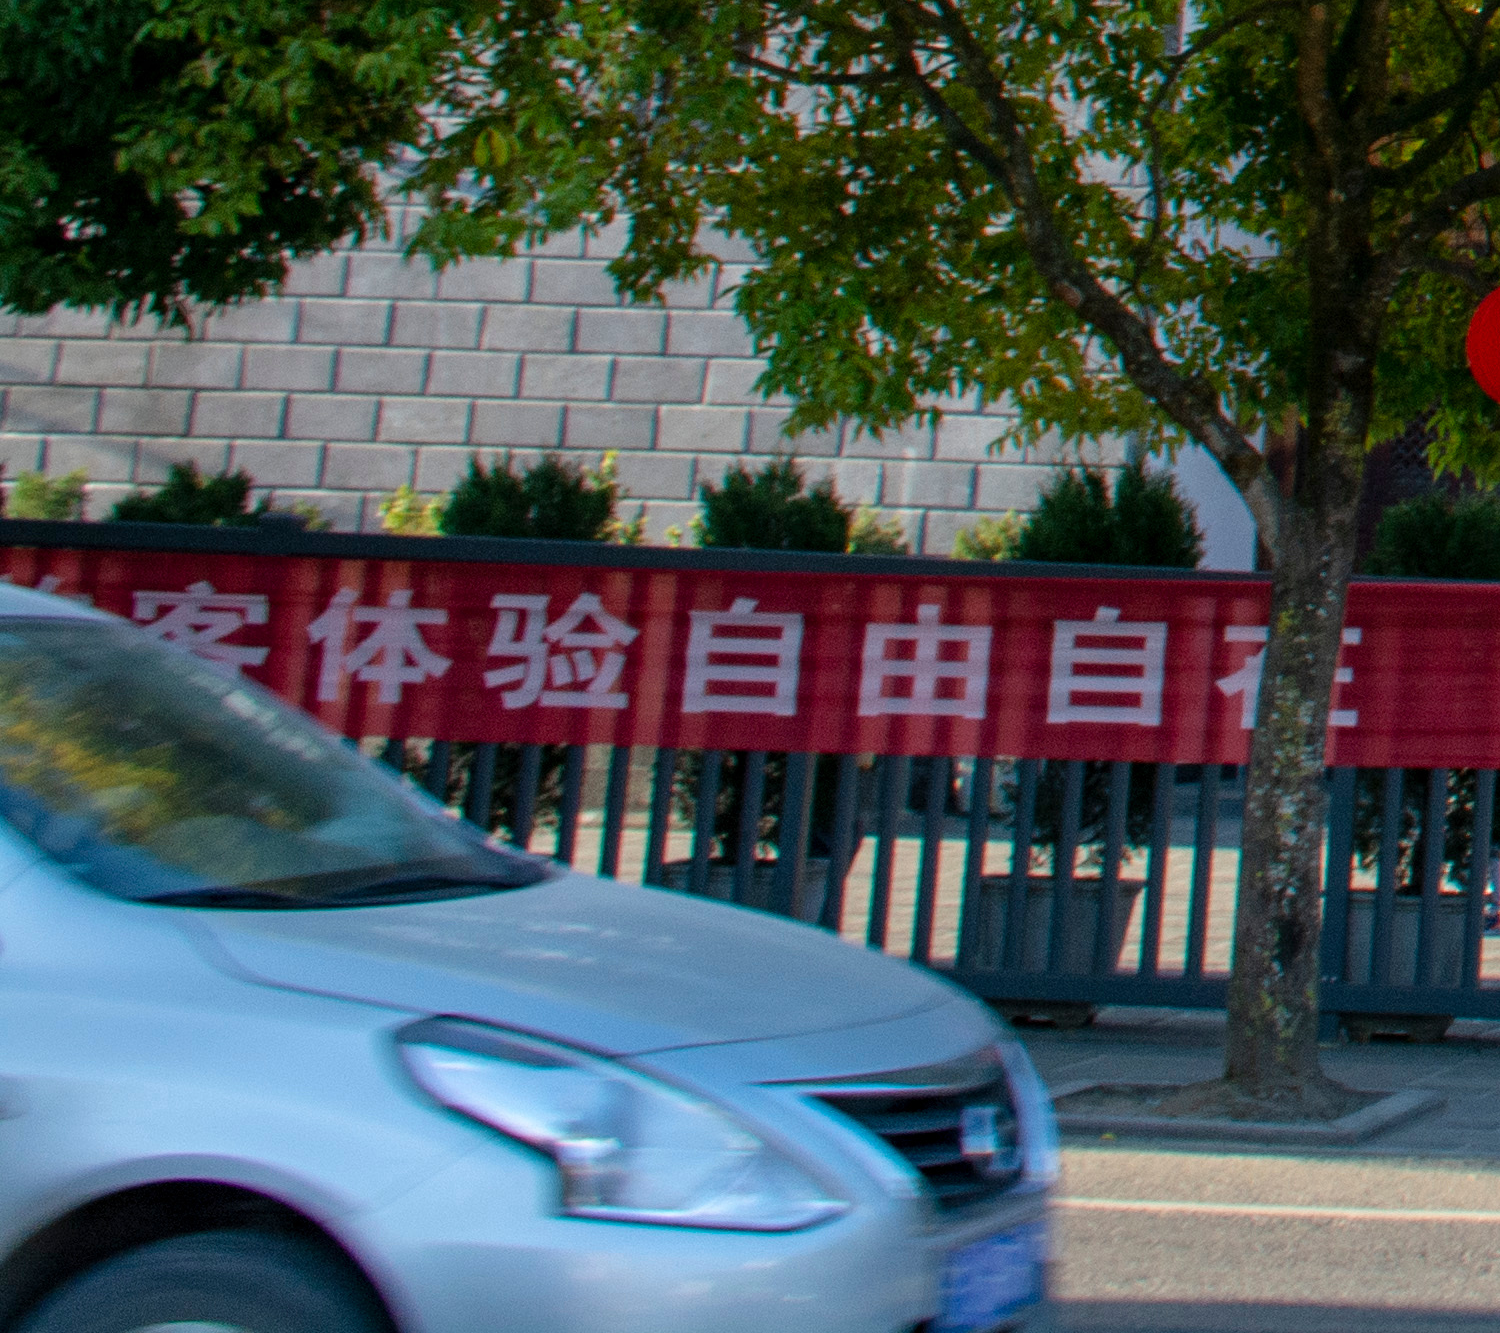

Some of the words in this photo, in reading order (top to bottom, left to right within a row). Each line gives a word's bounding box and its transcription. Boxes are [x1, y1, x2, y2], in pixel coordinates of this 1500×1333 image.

[0, 574, 1364, 729] 客体验自由自在
